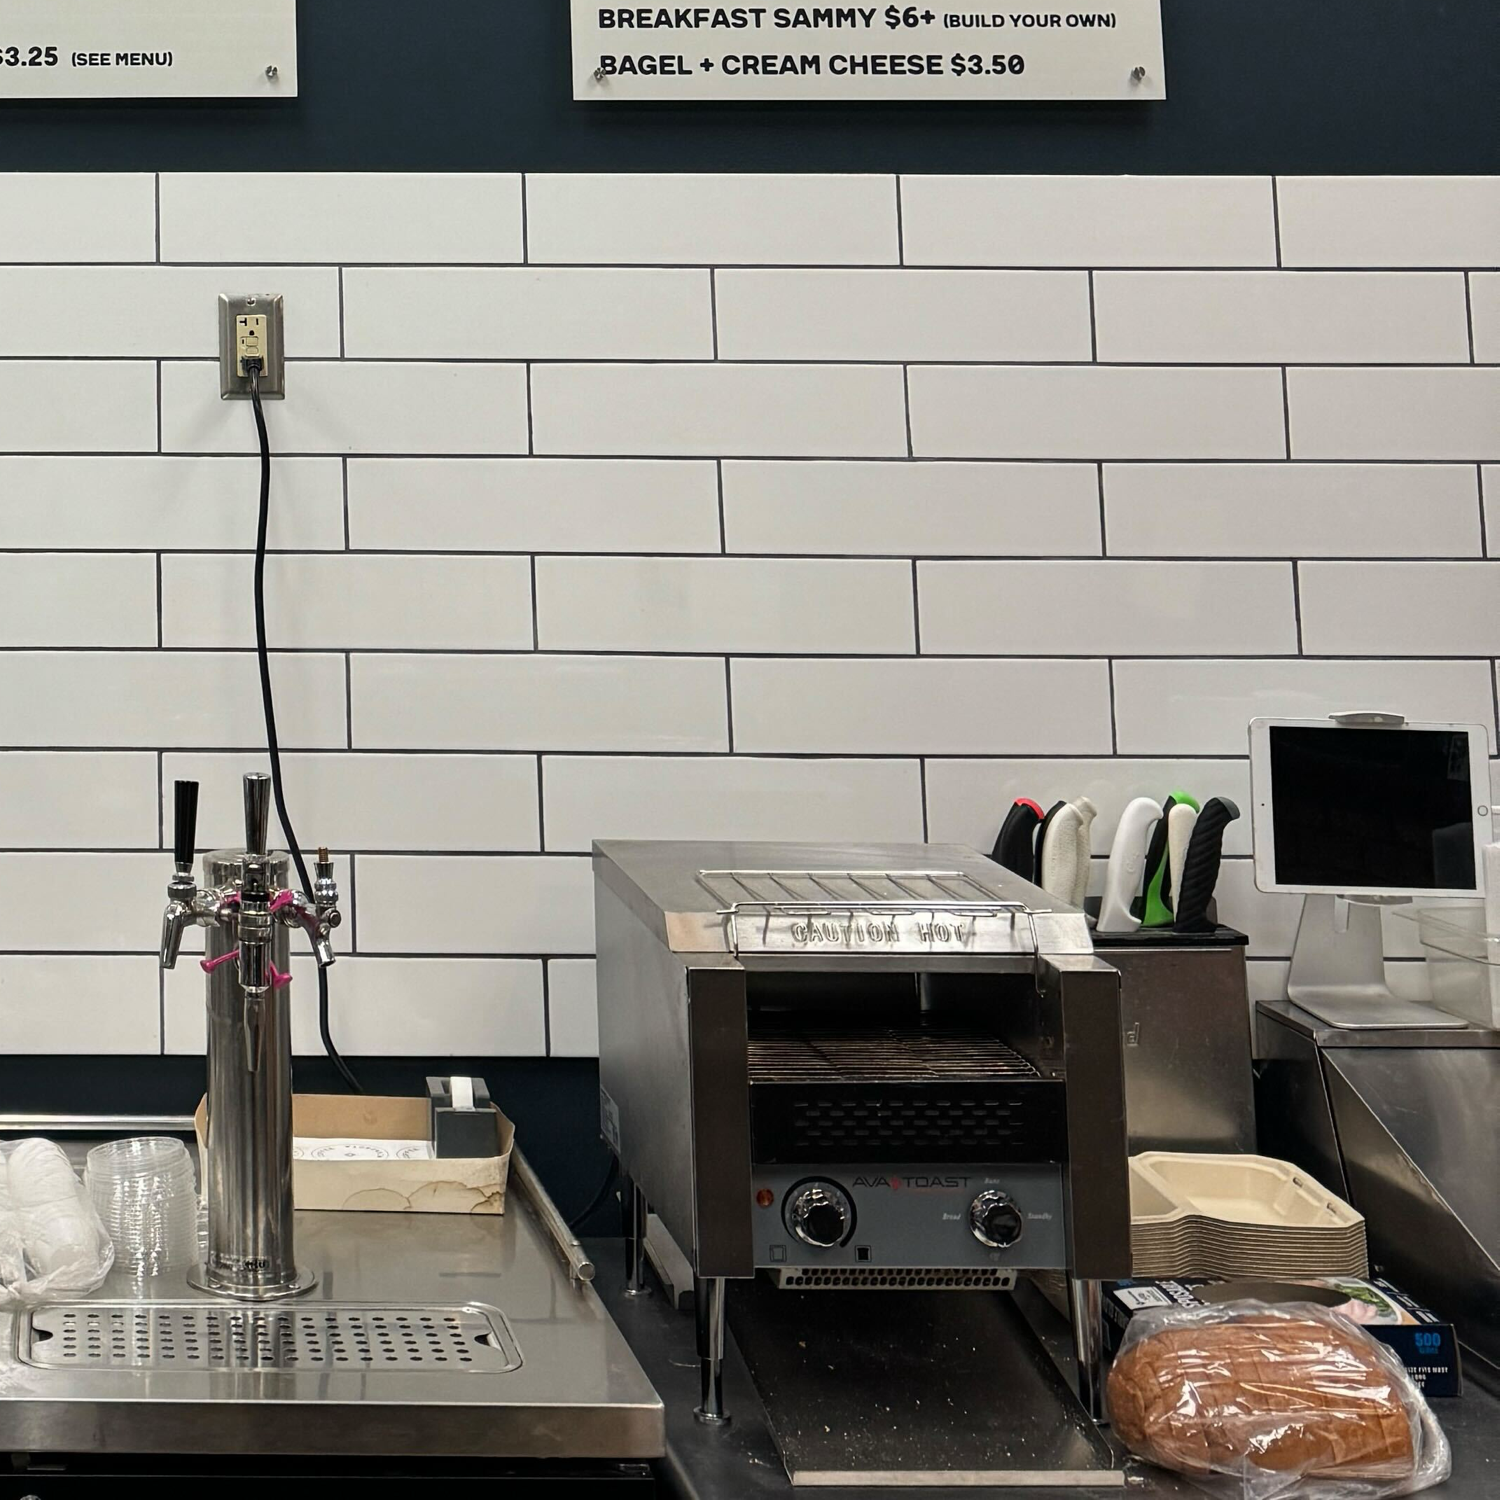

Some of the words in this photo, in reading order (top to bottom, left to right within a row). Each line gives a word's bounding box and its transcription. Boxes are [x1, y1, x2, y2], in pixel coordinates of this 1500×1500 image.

[598, 8, 767, 29] BREAKFAST
[773, 7, 877, 29] SAMMY
[943, 13, 1005, 29] (BUILD
[1008, 14, 1062, 28] YOUR
[1065, 12, 1116, 29] OWN)
[71, 51, 112, 68] (SEE
[115, 51, 173, 67] MENU)
[600, 54, 693, 76] BAGEL
[699, 57, 715, 72] +
[721, 54, 821, 76] CREAM
[828, 54, 944, 76] CHEESE
[950, 52, 1025, 77] $3.50
[790, 921, 901, 943] CAUTION
[918, 921, 964, 943] HOT
[1414, 1332, 1442, 1347] 500
